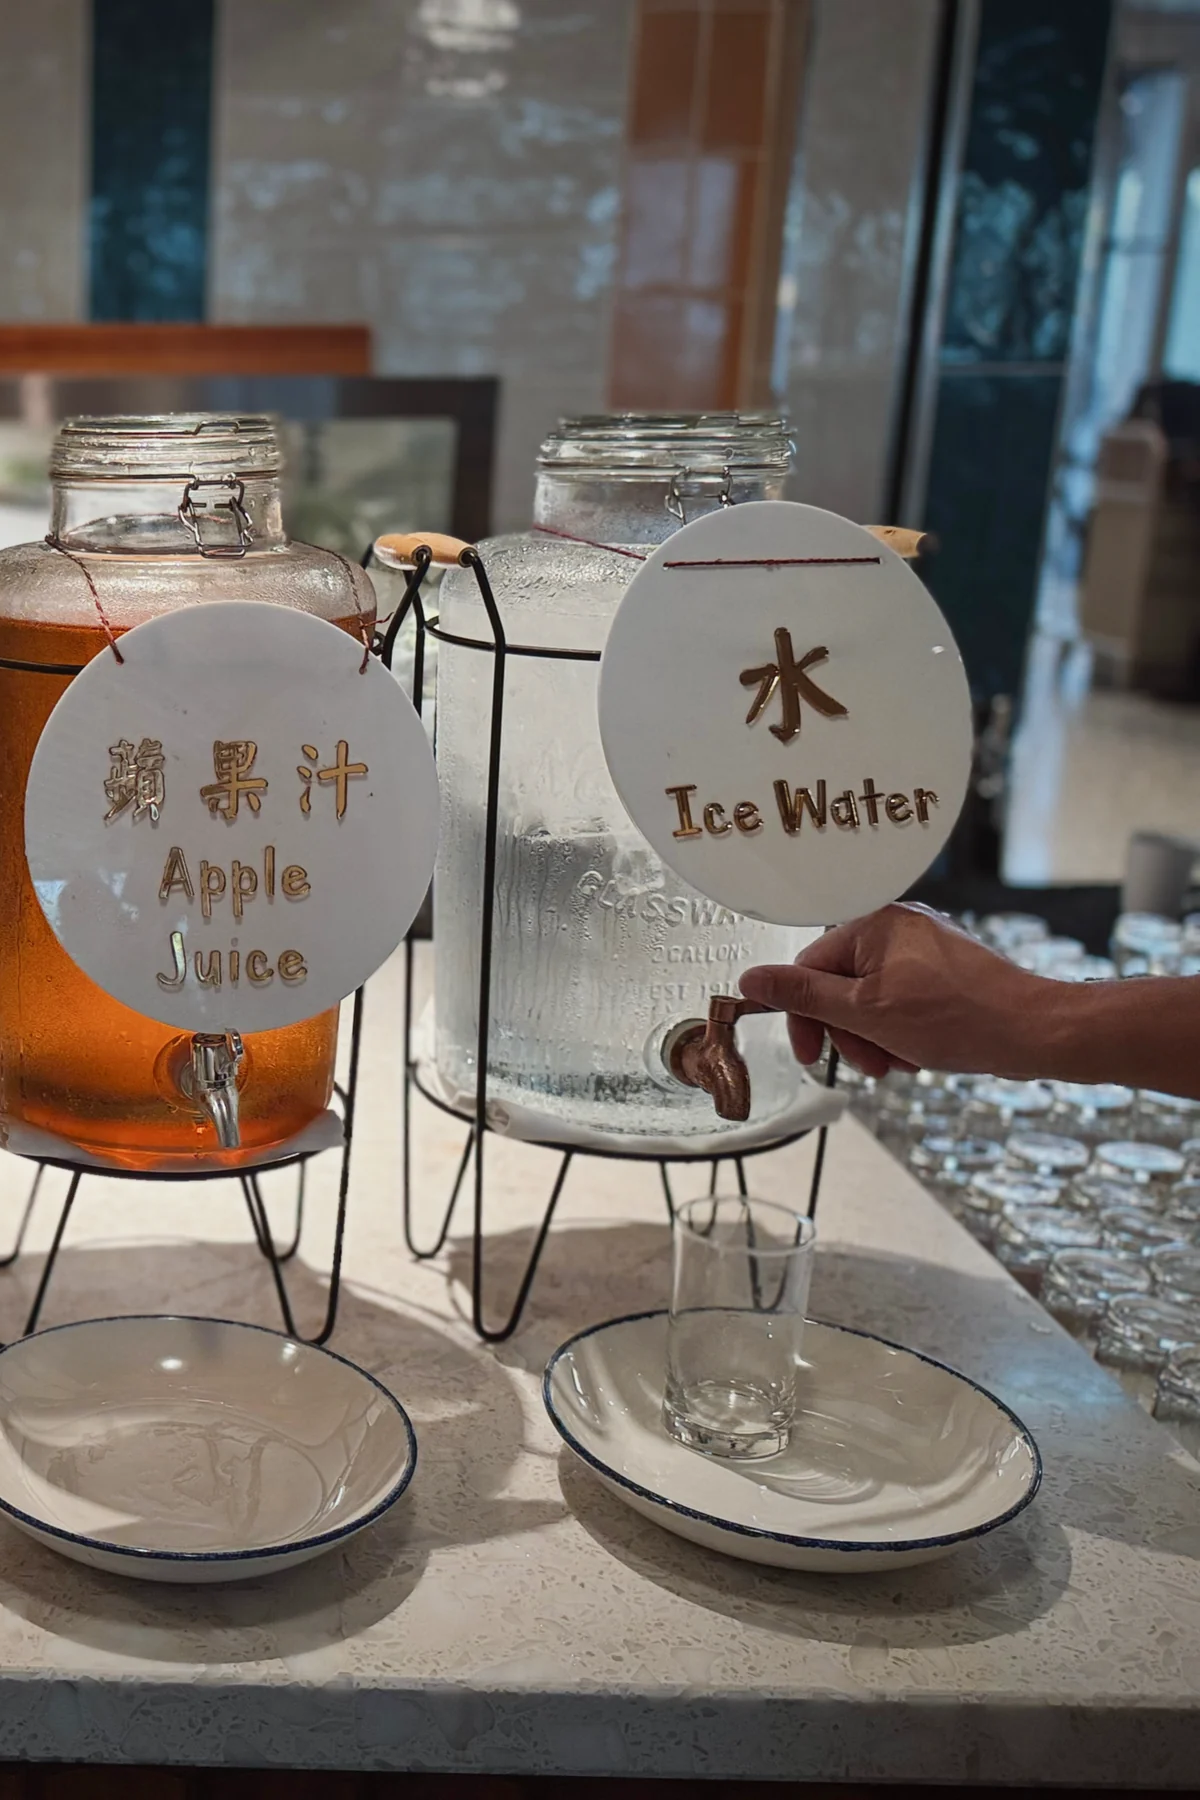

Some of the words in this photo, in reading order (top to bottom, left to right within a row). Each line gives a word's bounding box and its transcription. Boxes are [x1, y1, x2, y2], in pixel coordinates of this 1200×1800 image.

[739, 627, 849, 744] 水
[103, 738, 369, 822] 蘋果汁
[665, 784, 764, 838] Ice
[773, 778, 940, 834] Water
[159, 845, 311, 917] Apple
[575, 870, 744, 927] GLASSWA
[156, 931, 308, 987] Juice
